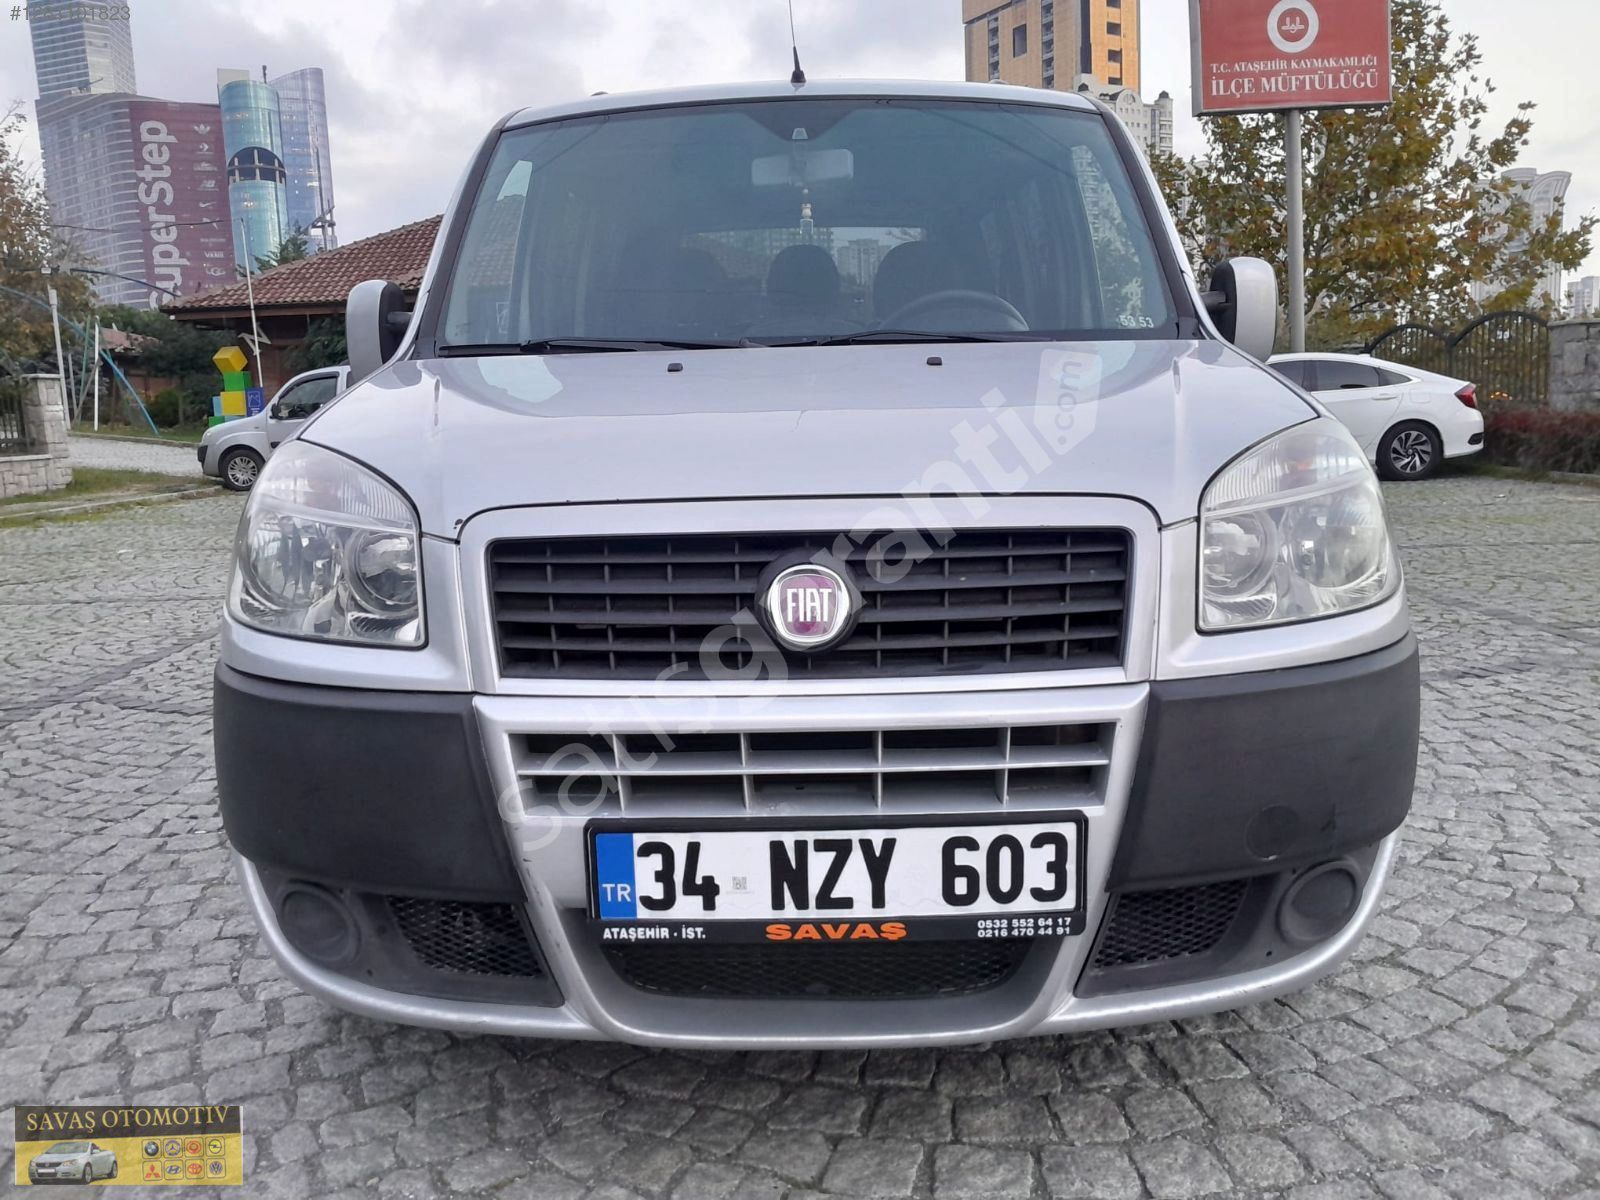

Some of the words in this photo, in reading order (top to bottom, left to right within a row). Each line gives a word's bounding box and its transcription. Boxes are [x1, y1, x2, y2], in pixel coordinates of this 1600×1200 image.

[1210, 63, 1231, 73] T.C.
[1233, 58, 1288, 73] ATAŞEHİR
[1290, 55, 1377, 70] KAYMAKAMLIĞI
[1211, 76, 1256, 98] İLÇE
[1261, 69, 1379, 92] MÜFTÜLÜĞÜ
[786, 588, 833, 623] FIAT
[637, 841, 720, 912] 34
[769, 838, 897, 911] NZY
[941, 832, 1069, 906] 603
[602, 883, 632, 903] TR
[603, 925, 670, 942] ATAŞEHİR
[681, 924, 706, 939] İST.
[765, 922, 908, 942] SAVAŞ
[977, 919, 1008, 929] 0532
[1011, 918, 1034, 928] 552
[1037, 917, 1053, 926] 64
[1057, 917, 1072, 926] 17
[977, 928, 1008, 938] 0216
[1011, 927, 1034, 936] 470
[1037, 927, 1053, 936] 44
[1056, 926, 1070, 935] 91
